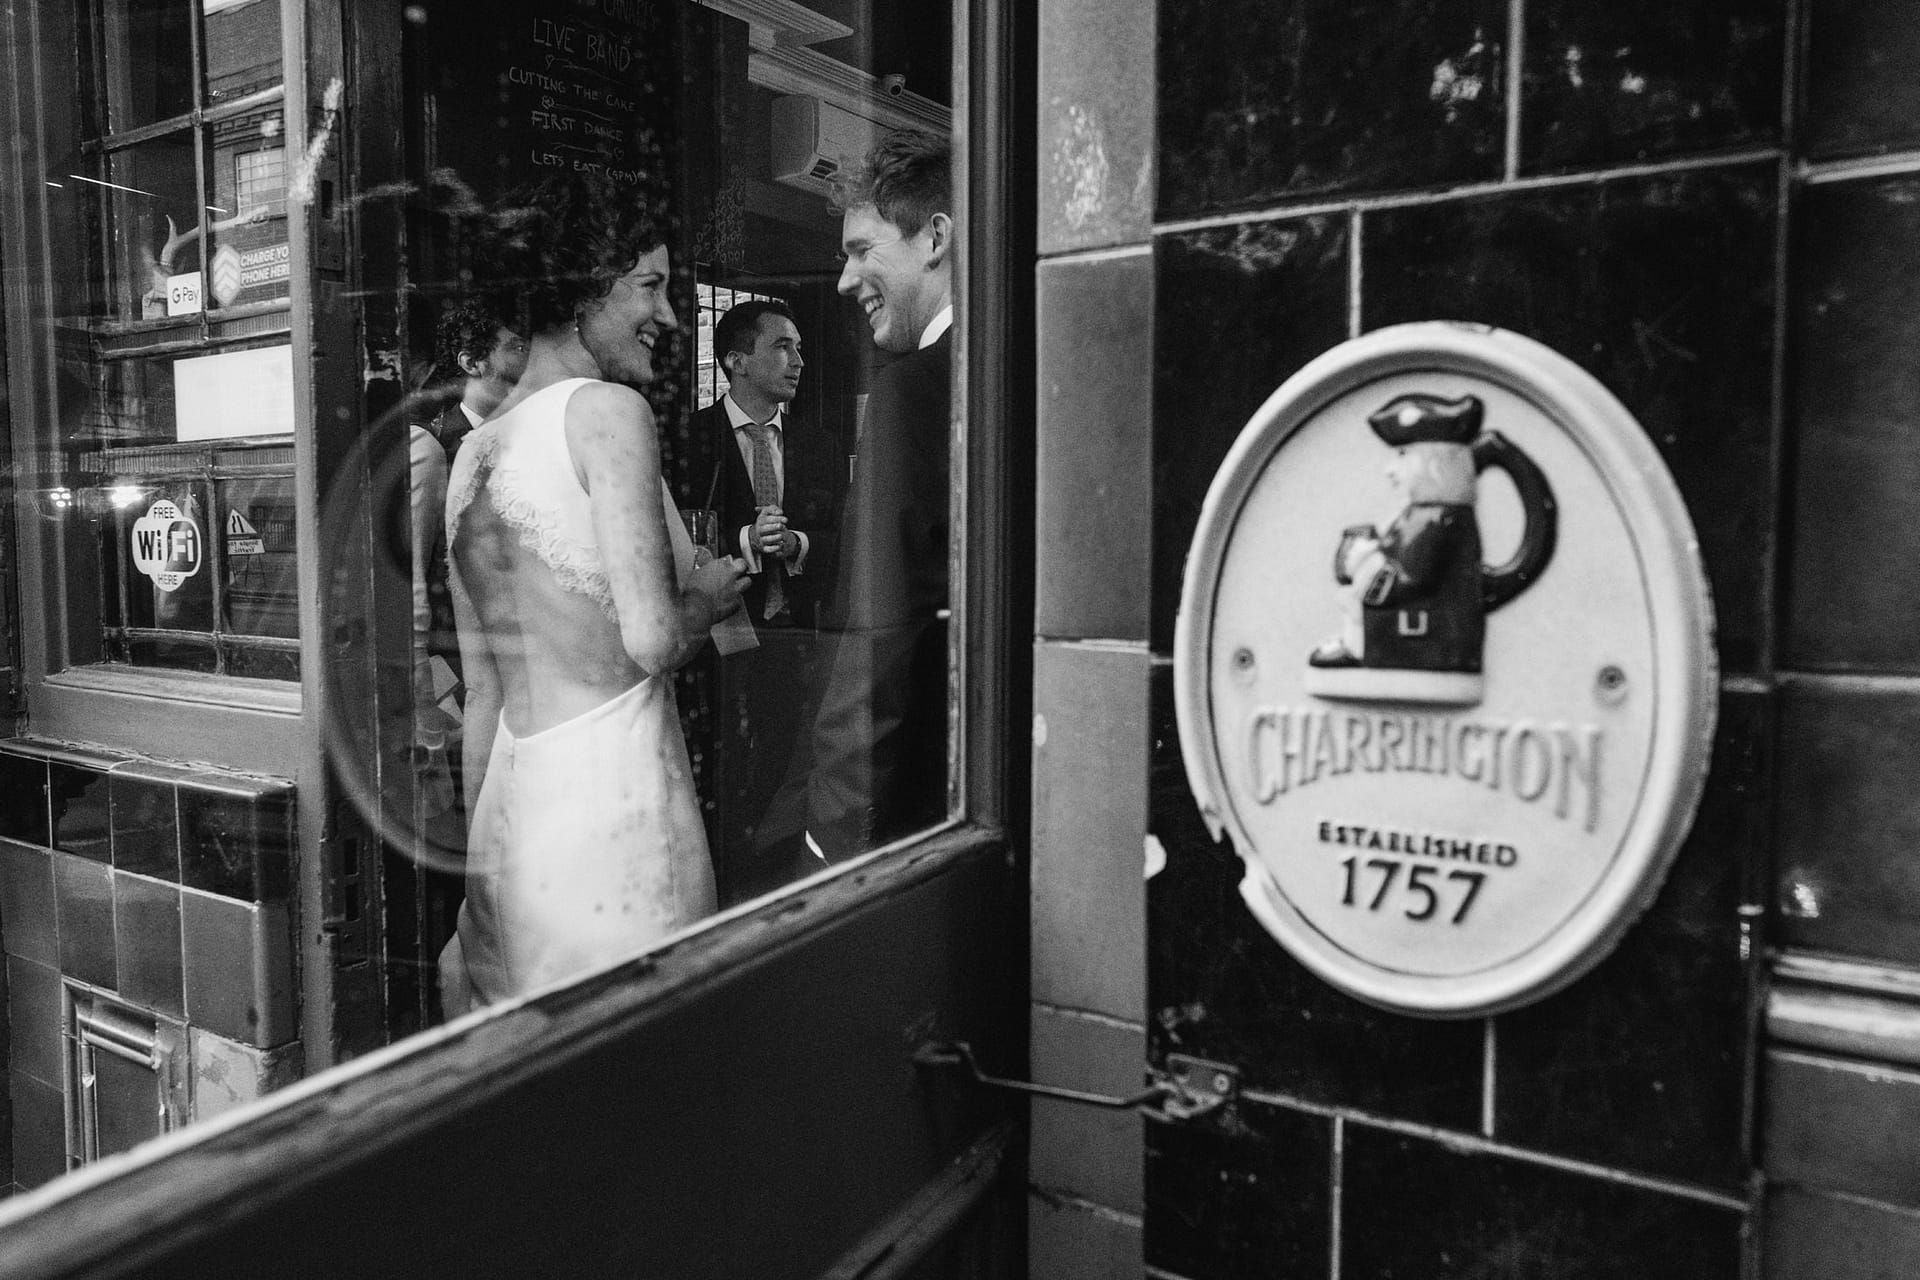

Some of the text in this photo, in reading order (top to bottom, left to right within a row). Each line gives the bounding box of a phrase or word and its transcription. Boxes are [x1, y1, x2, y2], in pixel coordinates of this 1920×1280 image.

[533, 18, 631, 72] LIVE BAND
[509, 67, 636, 112] CUTTING THE CAKE
[531, 110, 624, 142] FIRST DANCE
[532, 149, 566, 167] LETS
[573, 159, 602, 174] EAT
[241, 249, 275, 267] CHARGE
[241, 268, 270, 285] PHONE
[171, 286, 200, 304] G Pay
[153, 506, 174, 520] FREE
[157, 573, 179, 586] HERE
[1251, 710, 1604, 835] CHARRINGTON
[1317, 821, 1519, 867] ESTABLISHED
[1341, 856, 1487, 925] 1757
